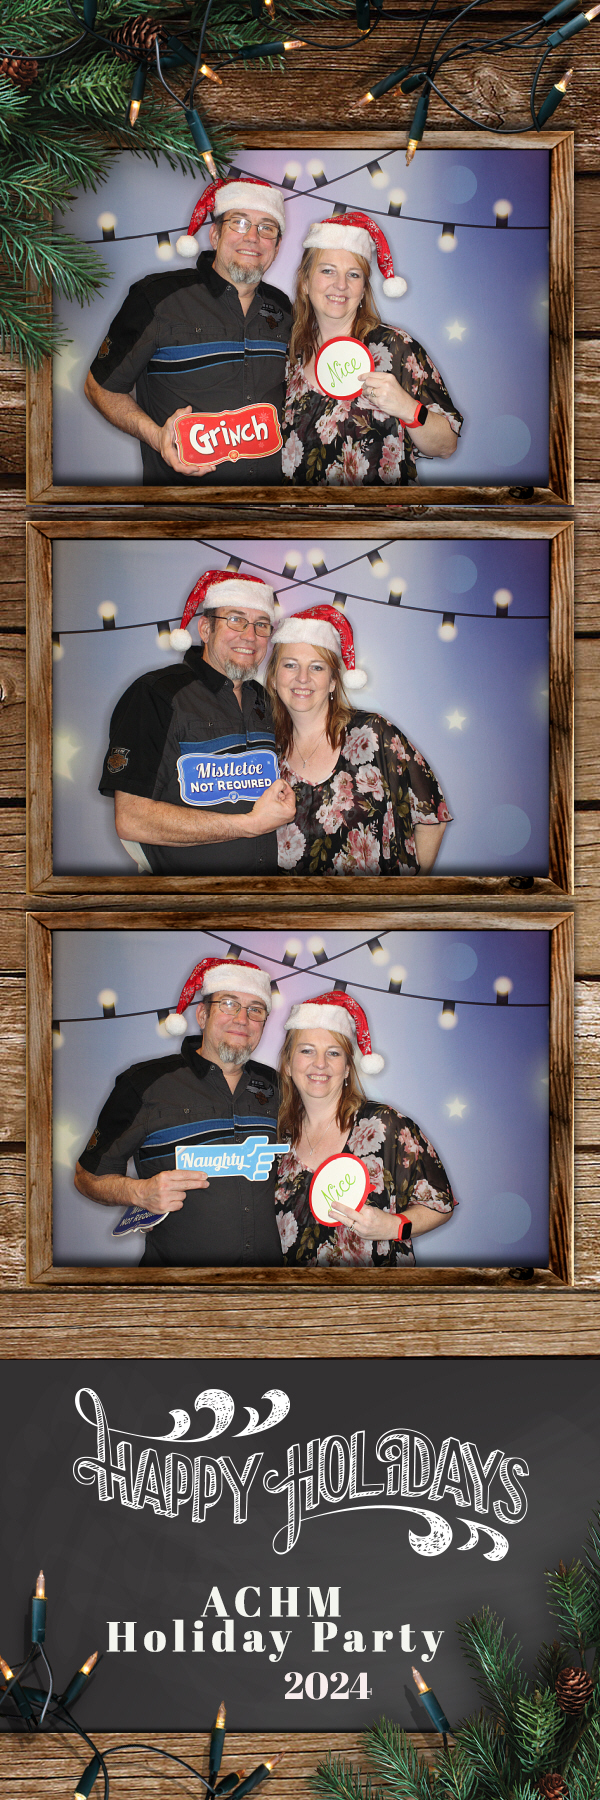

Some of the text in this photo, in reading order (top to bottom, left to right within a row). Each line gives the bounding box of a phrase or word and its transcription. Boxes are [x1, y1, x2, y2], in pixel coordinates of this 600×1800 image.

[327, 358, 362, 388] Nice
[195, 762, 264, 779] Mistletoe
[190, 778, 273, 793] NOT REQUIRED
[180, 1152, 252, 1172] Naughty
[320, 1173, 357, 1213] Nice
